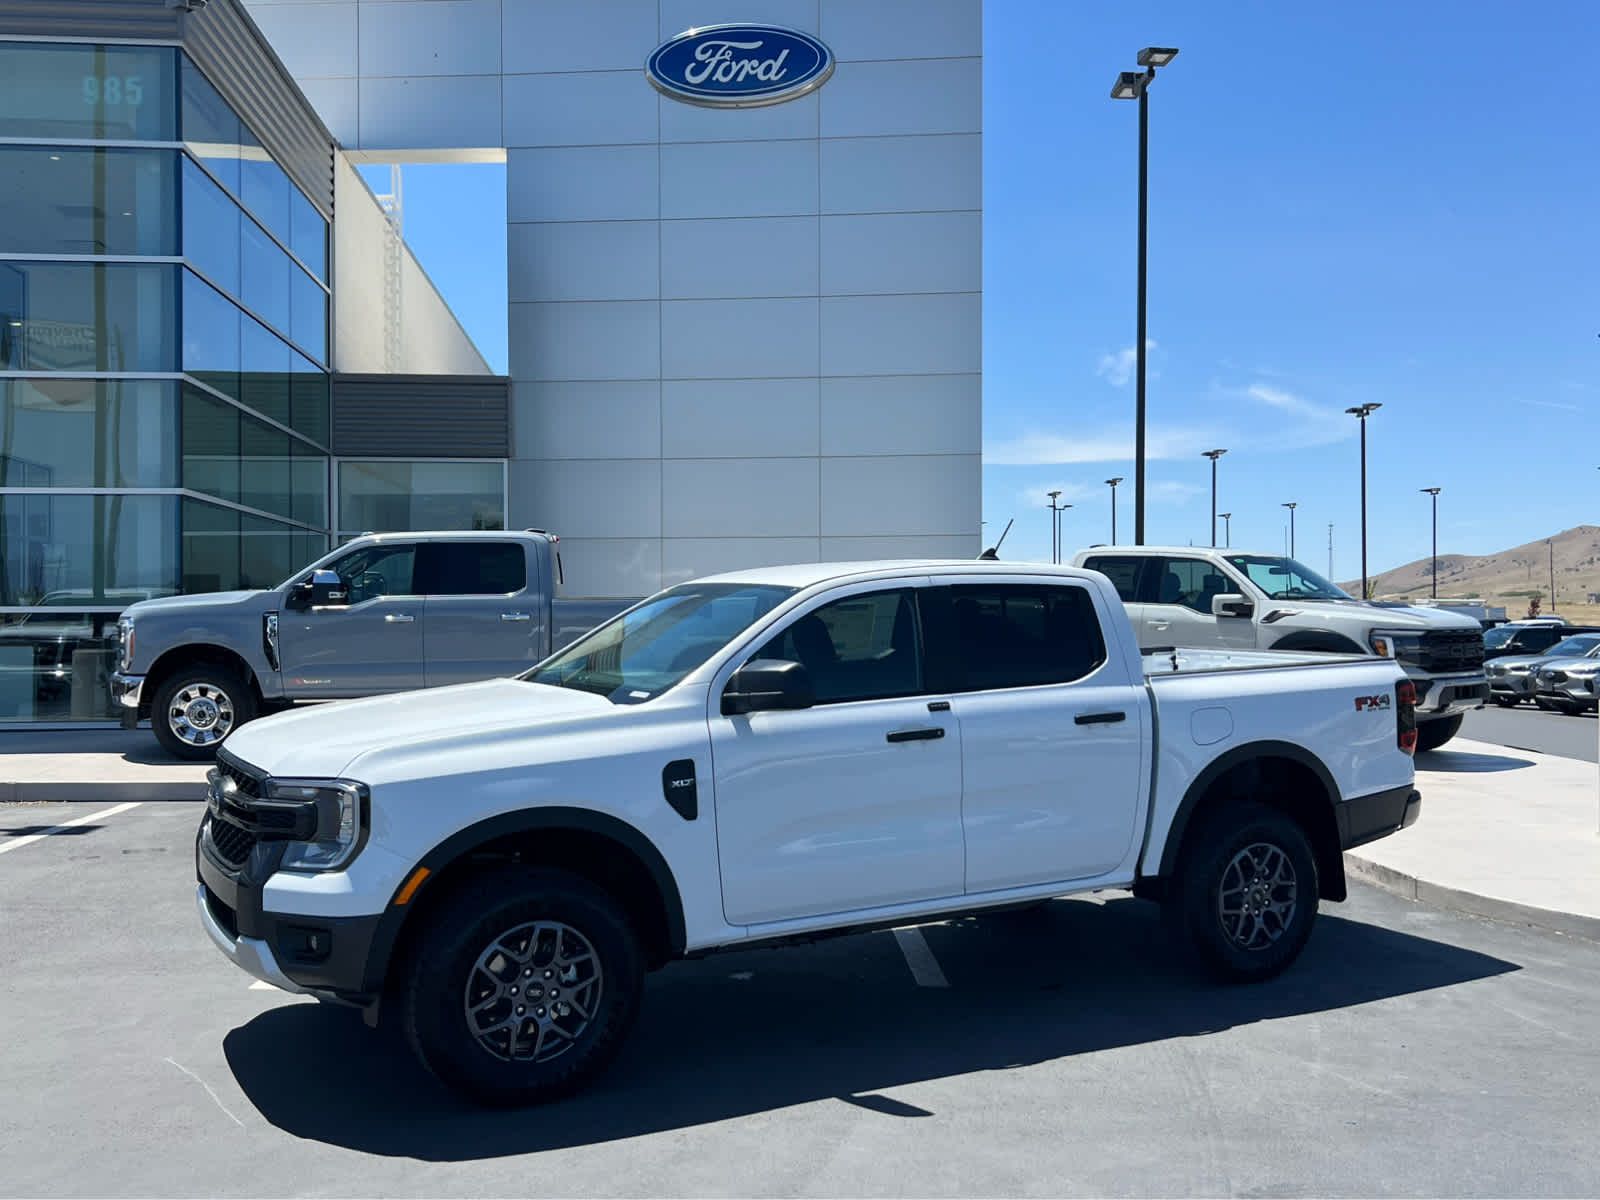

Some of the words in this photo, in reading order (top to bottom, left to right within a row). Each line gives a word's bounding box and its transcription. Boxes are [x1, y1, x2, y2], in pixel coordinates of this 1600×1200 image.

[684, 40, 790, 84] Ford
[82, 76, 143, 105] 985
[1354, 694, 1390, 712] FX4
[671, 778, 695, 788] XLT
